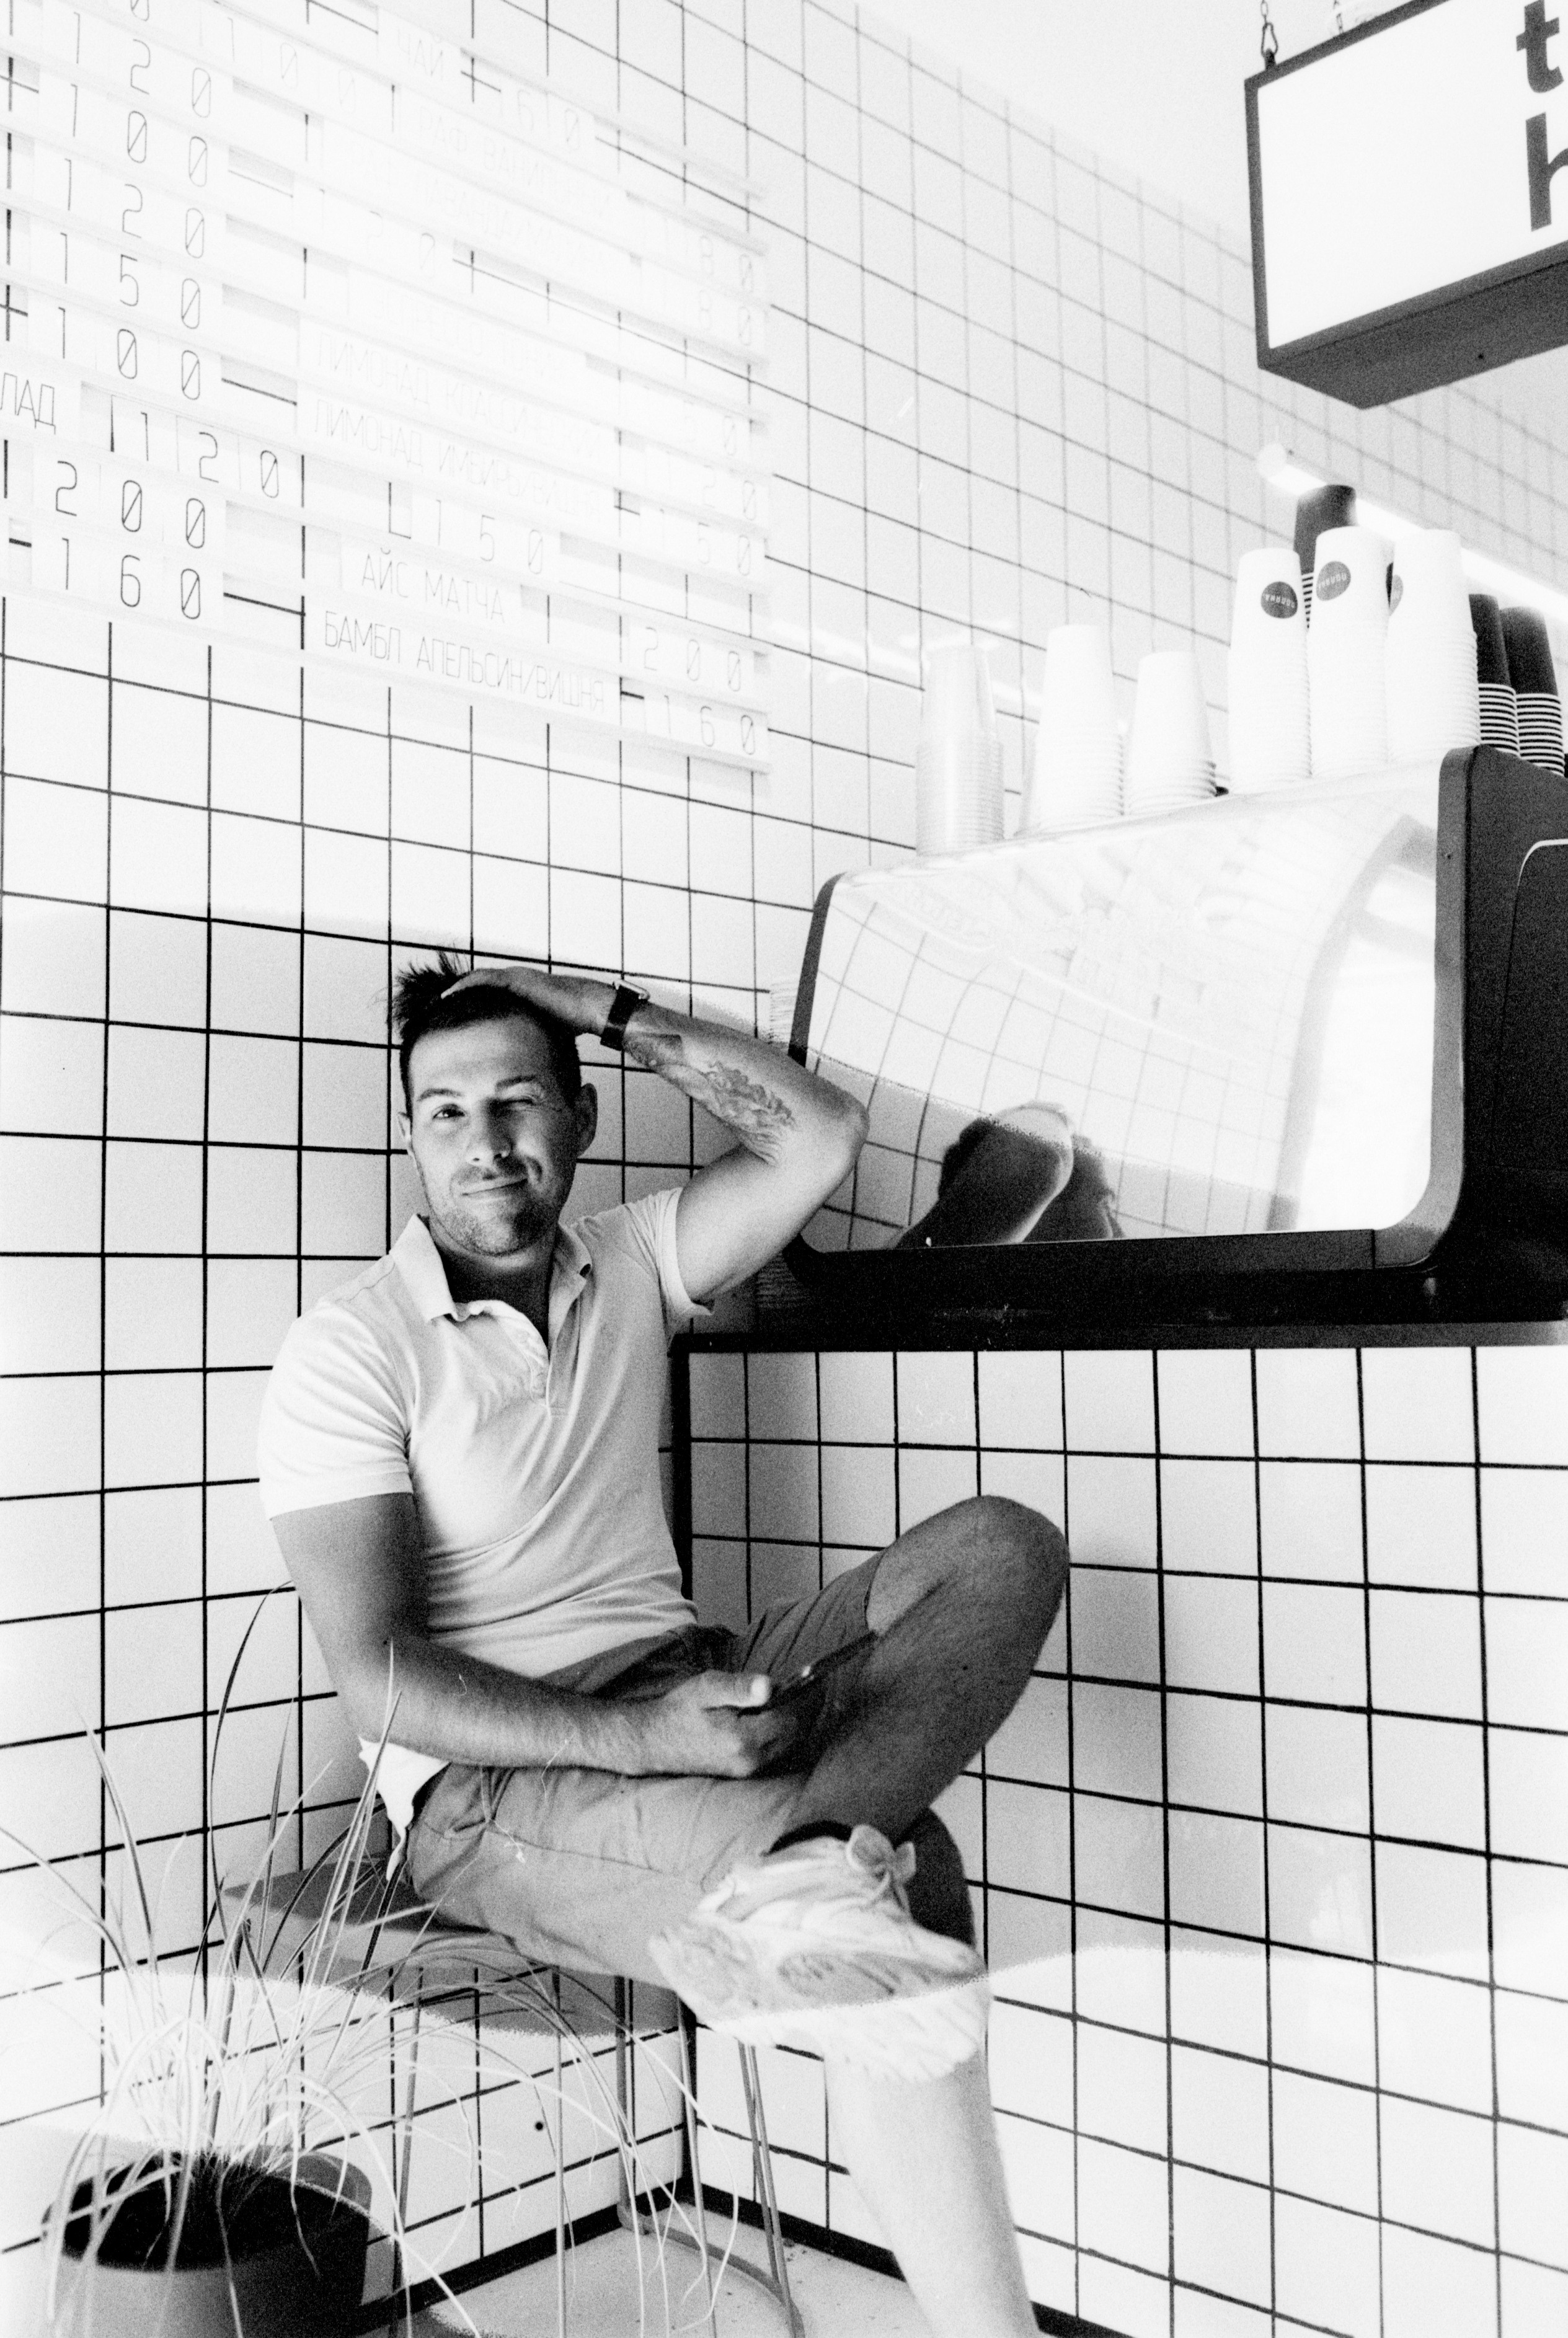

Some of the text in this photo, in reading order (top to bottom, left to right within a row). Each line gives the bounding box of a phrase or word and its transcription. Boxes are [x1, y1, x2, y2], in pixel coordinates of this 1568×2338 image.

[73, 11, 212, 118] 120
[70, 82, 208, 188] 100
[64, 157, 205, 259] 120
[60, 231, 201, 330] 150
[58, 306, 201, 401] 100
[55, 459, 206, 549] 200
[61, 537, 201, 620] 160
[361, 547, 409, 599] АЙС
[424, 570, 505, 623] МАТЧА
[324, 609, 402, 663] БАМБЛ
